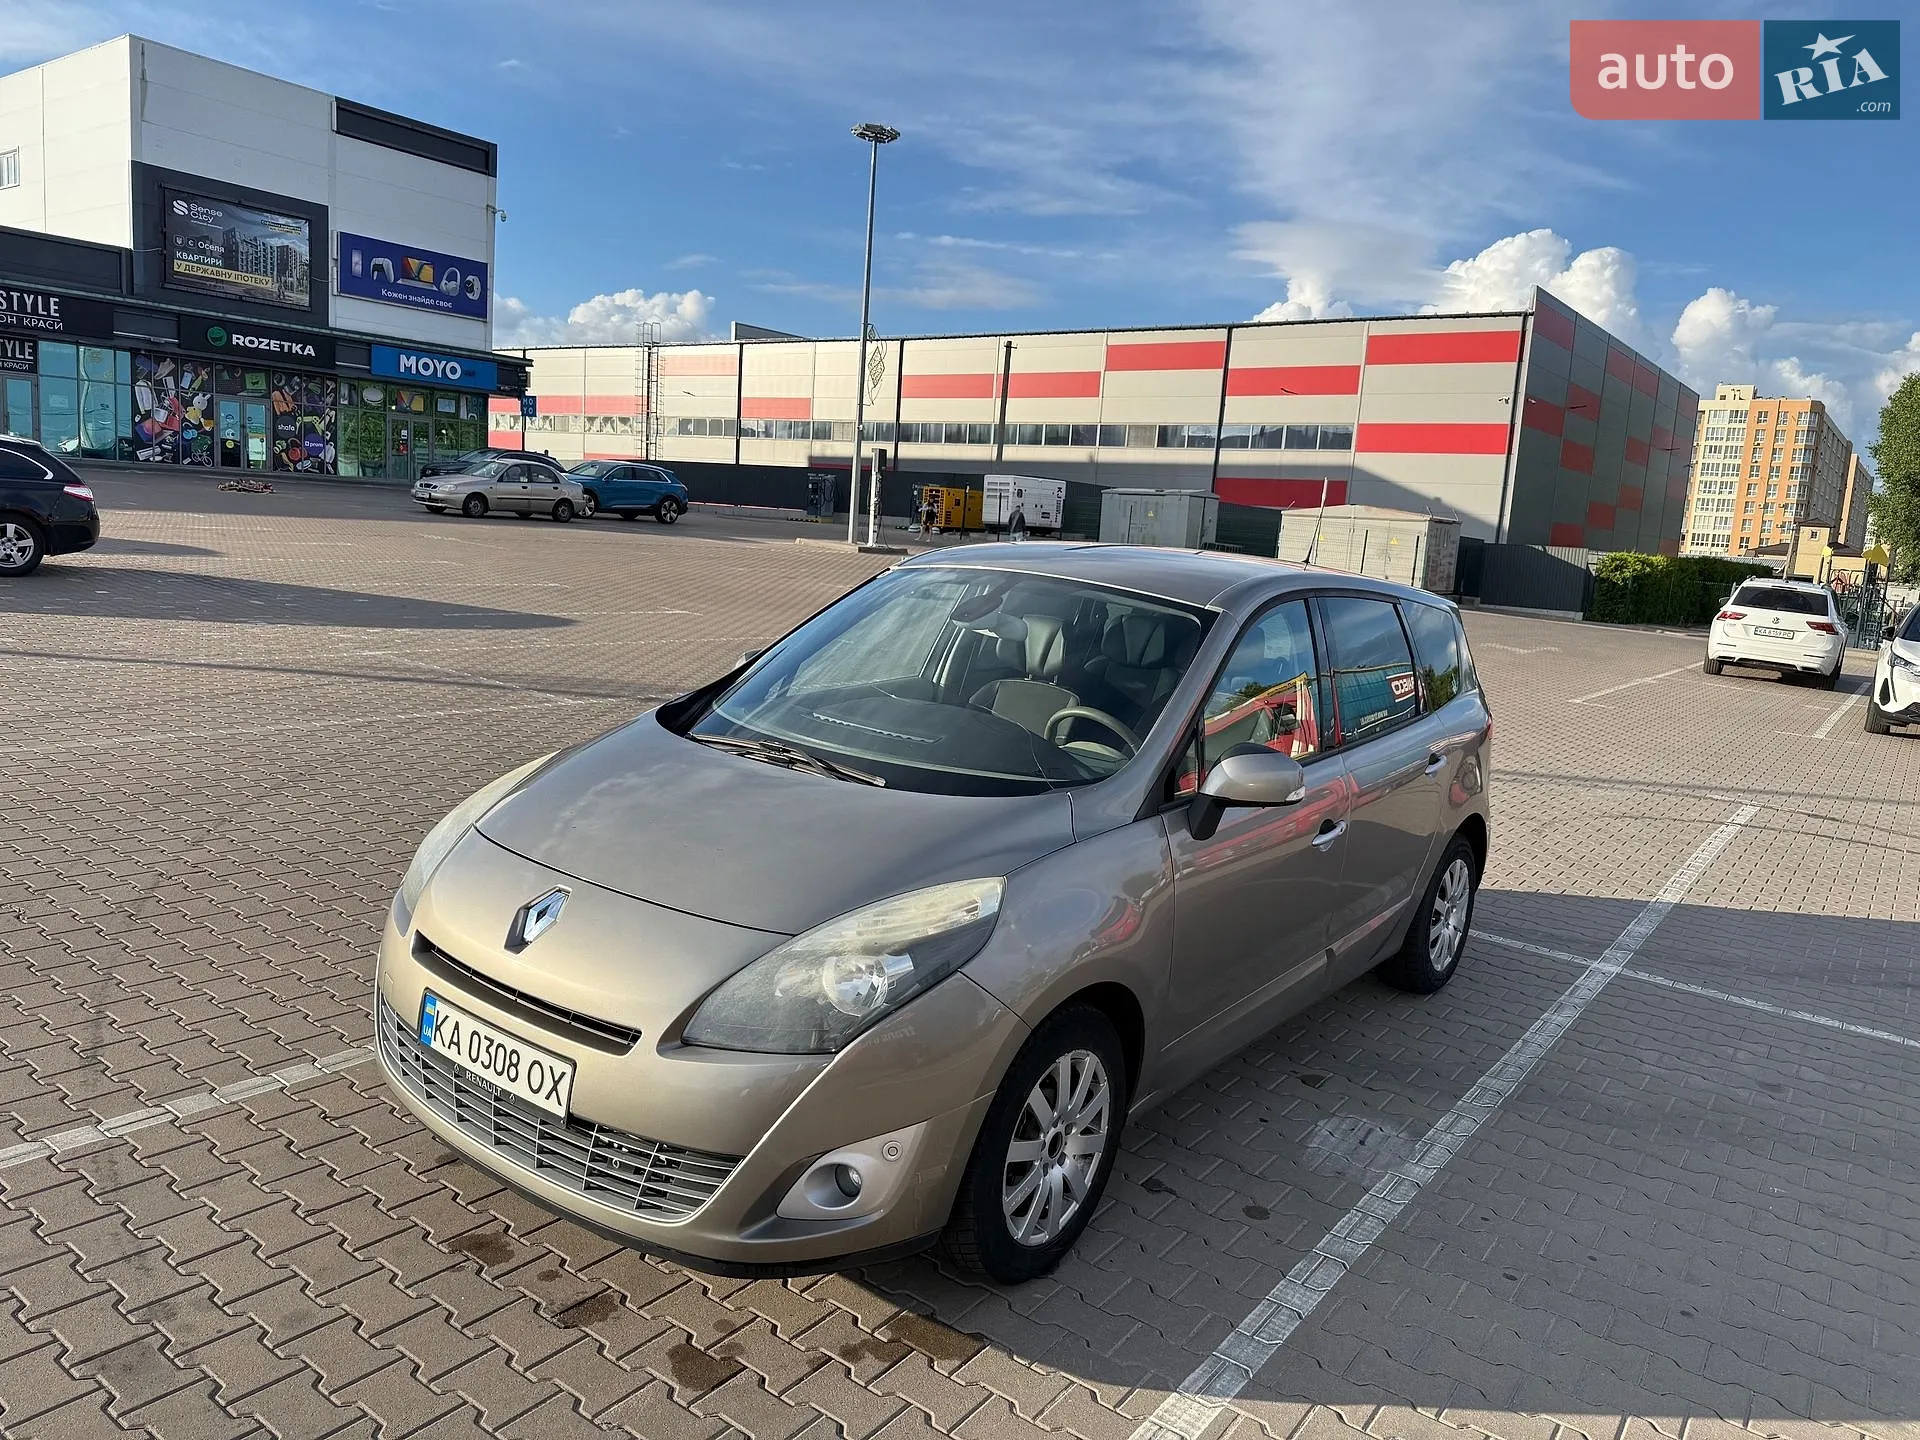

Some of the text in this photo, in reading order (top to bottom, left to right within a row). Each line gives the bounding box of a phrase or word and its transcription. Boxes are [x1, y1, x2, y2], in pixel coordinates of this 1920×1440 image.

[190, 203, 223, 218] Sense
[190, 211, 213, 223] City
[198, 241, 225, 253] Оселя
[176, 251, 222, 266] КВАРТИРИ
[175, 262, 270, 286] У ДЕРЖАВНУ ІПОТЕКУ
[0, 290, 60, 317] STYLE
[381, 288, 408, 300] Кожен
[408, 295, 435, 305] знайде
[23, 317, 63, 331] КРАСИ
[232, 333, 316, 357] ROZETKA
[4, 361, 29, 370] КРАСИ
[400, 354, 462, 380] MOYO
[278, 423, 295, 431] shafa
[423, 1024, 432, 1038] UA
[433, 1009, 567, 1107] KA 0308 OX
[465, 1070, 503, 1097] RENAULT
